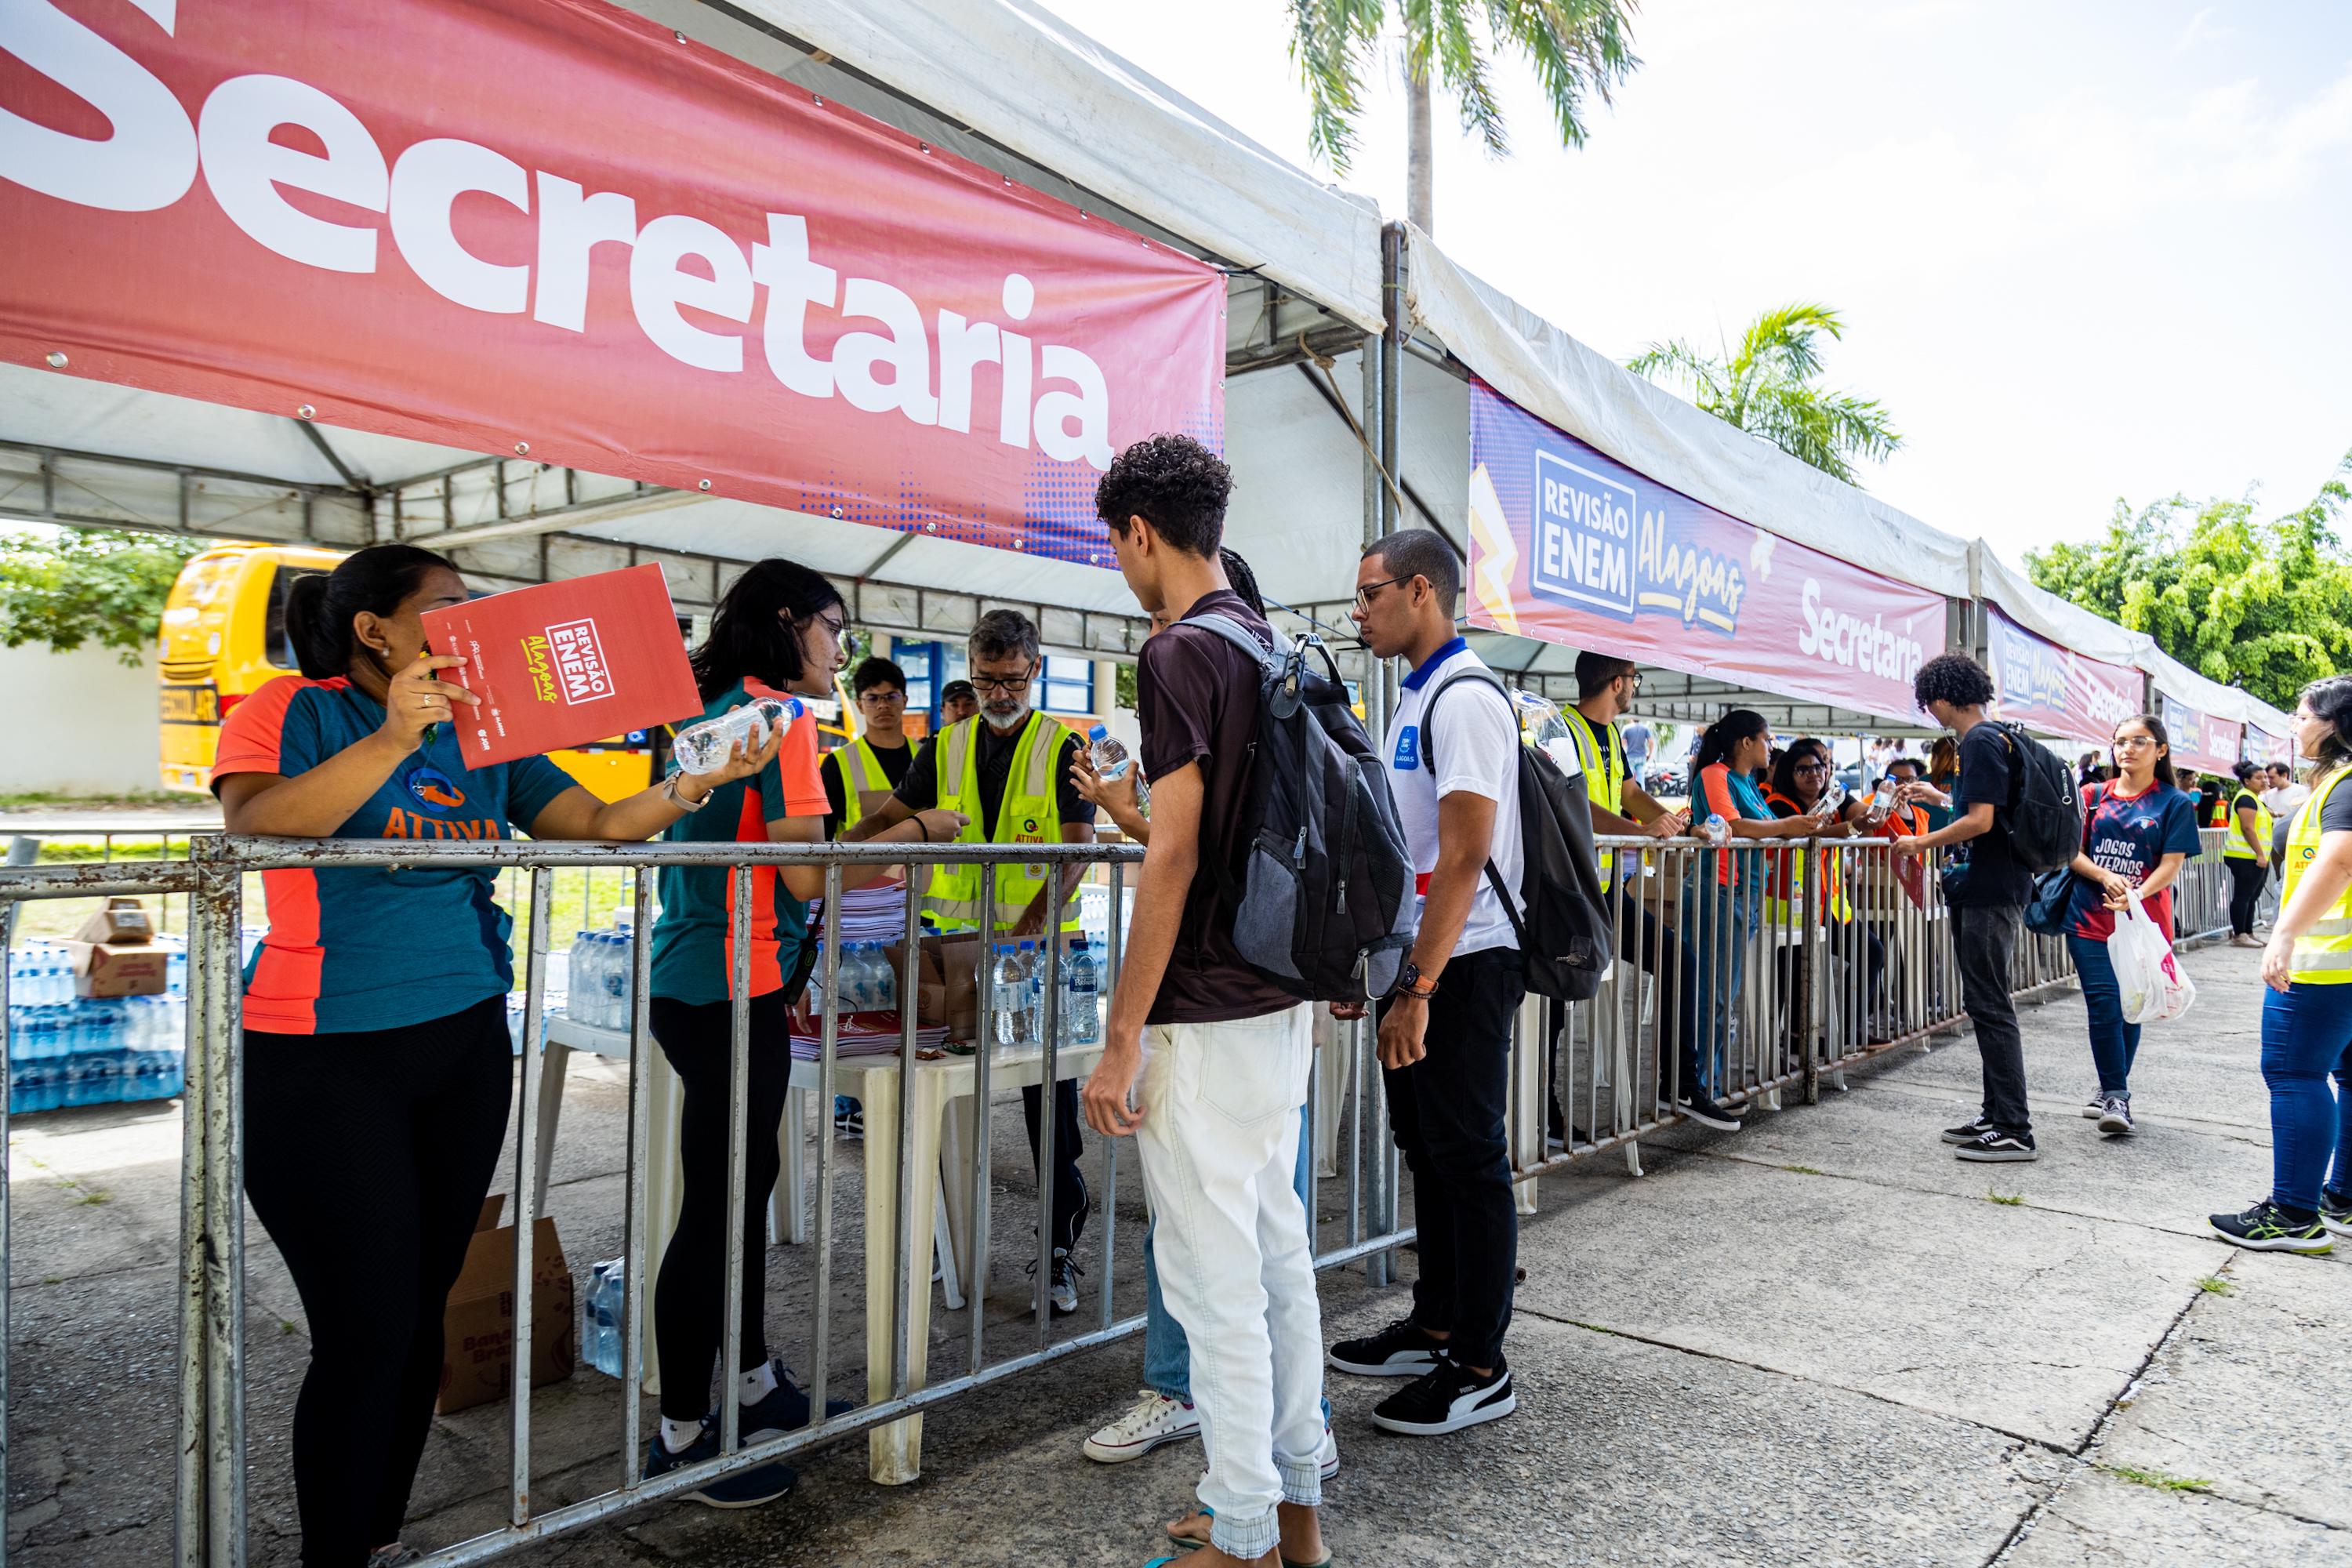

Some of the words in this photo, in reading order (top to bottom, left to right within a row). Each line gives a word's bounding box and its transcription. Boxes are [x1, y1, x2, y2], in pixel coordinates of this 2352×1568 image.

[0, 0, 1115, 472] Secretaria
[1544, 477, 1629, 540] REVISÃO
[1543, 521, 1627, 597] ENEM
[1639, 510, 1744, 622] Alagoas
[553, 629, 590, 698] ENEM
[575, 626, 605, 692] REVISÃO
[1798, 577, 1922, 687] Secretaria
[528, 636, 557, 703] Alagoas
[2005, 662, 2030, 697] ENEM
[382, 807, 500, 840] ATTIVA
[1015, 833, 1044, 844] ATTIVA
[2095, 838, 2136, 858] JOGOS
[2092, 855, 2144, 876] NTERNOS
